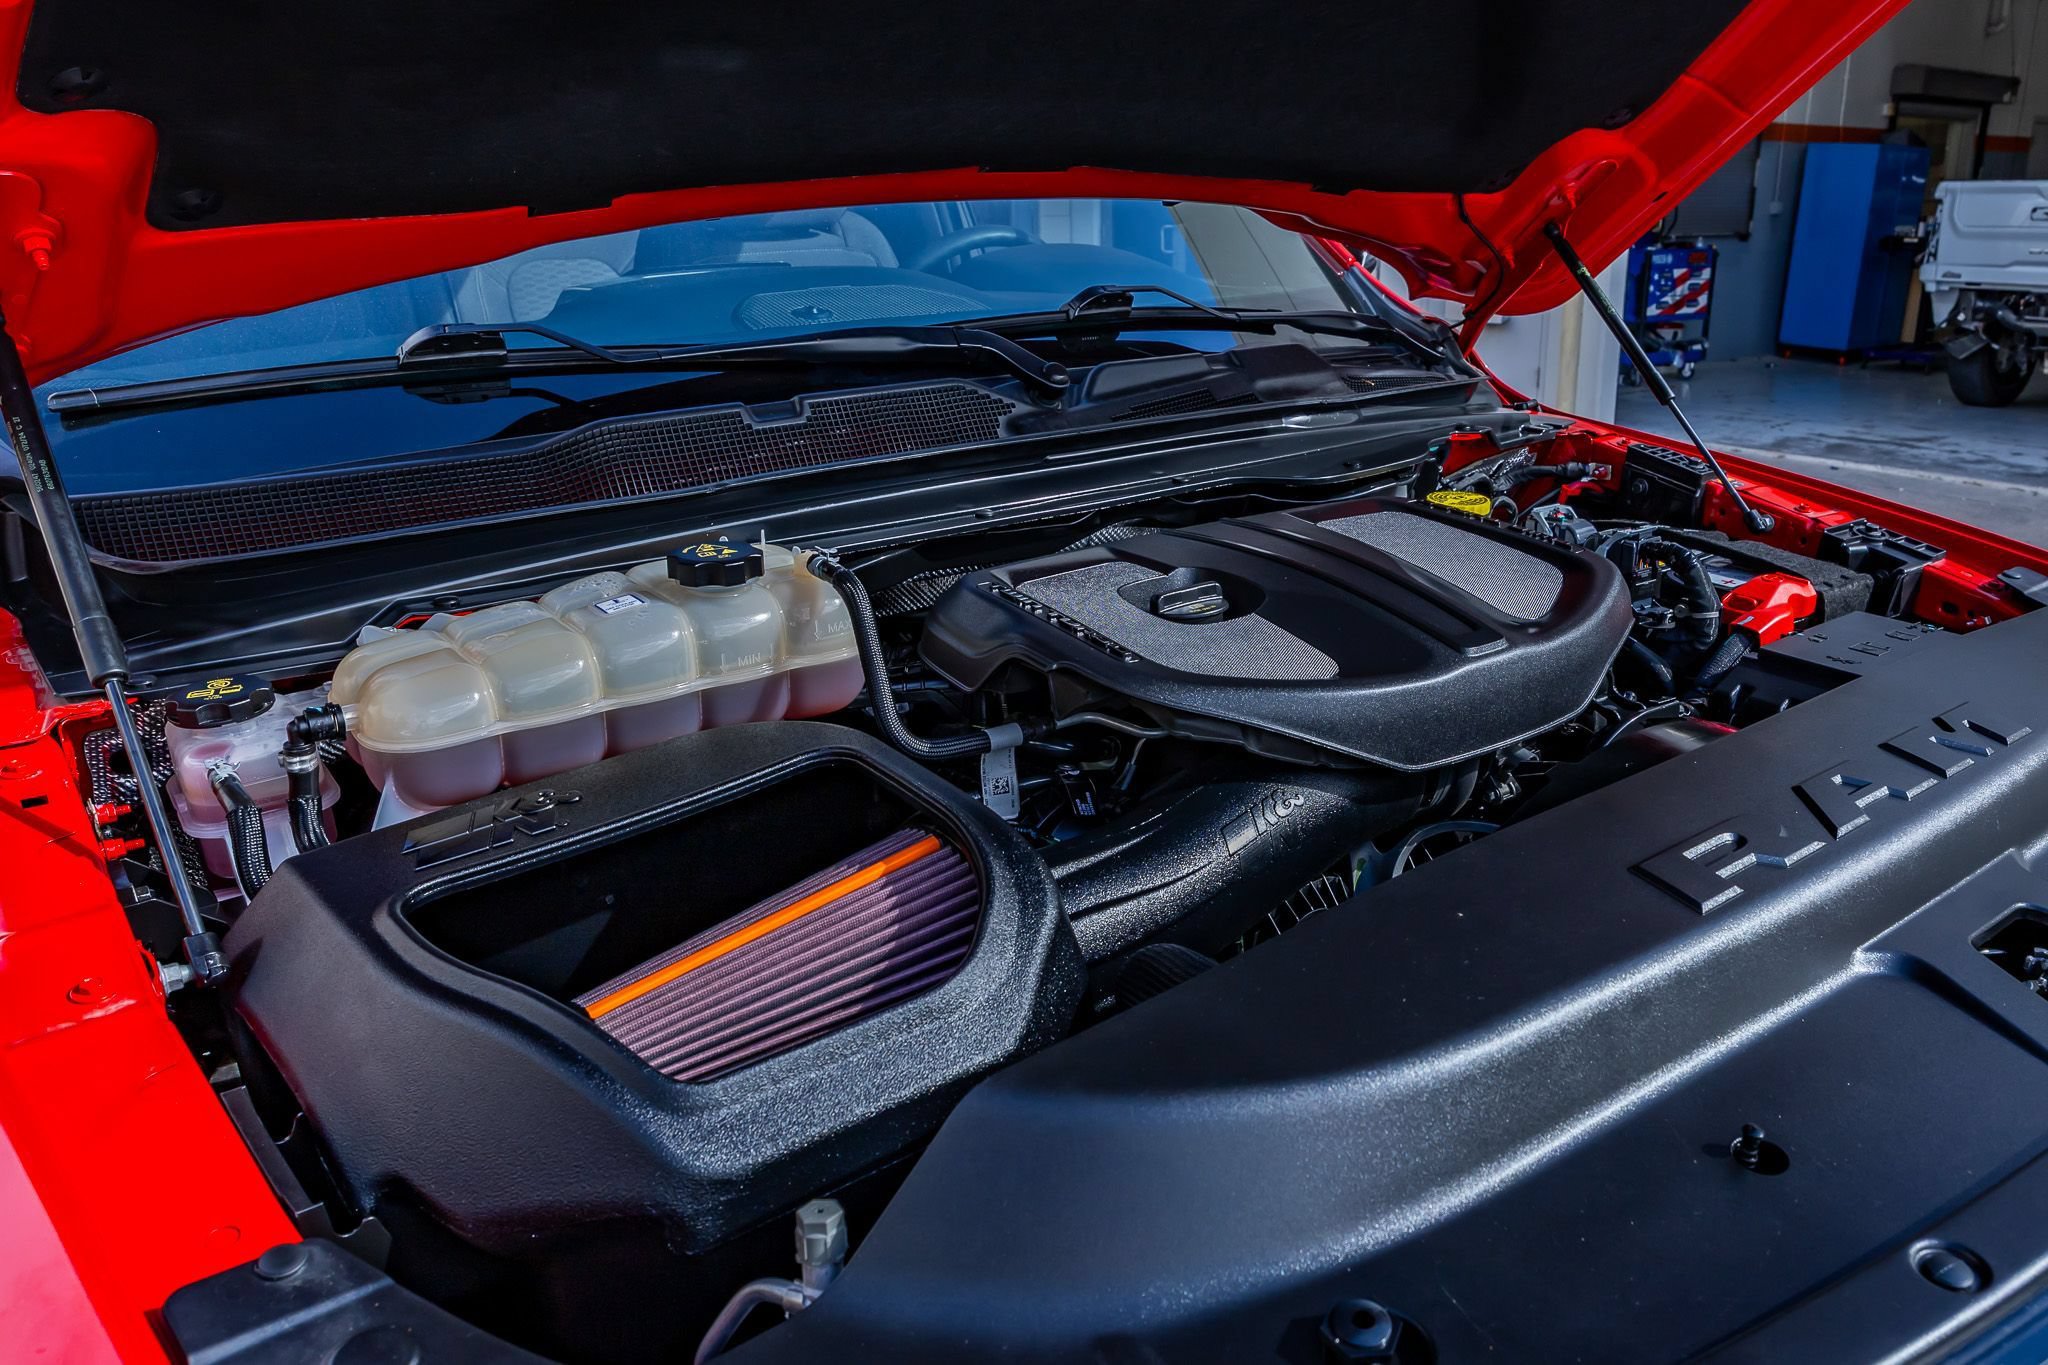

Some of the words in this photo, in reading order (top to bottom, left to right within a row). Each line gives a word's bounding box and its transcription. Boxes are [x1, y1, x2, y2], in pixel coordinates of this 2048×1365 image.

[827, 618, 853, 634] MAX
[737, 652, 761, 667] MIN
[1627, 701, 2032, 915] RAM
